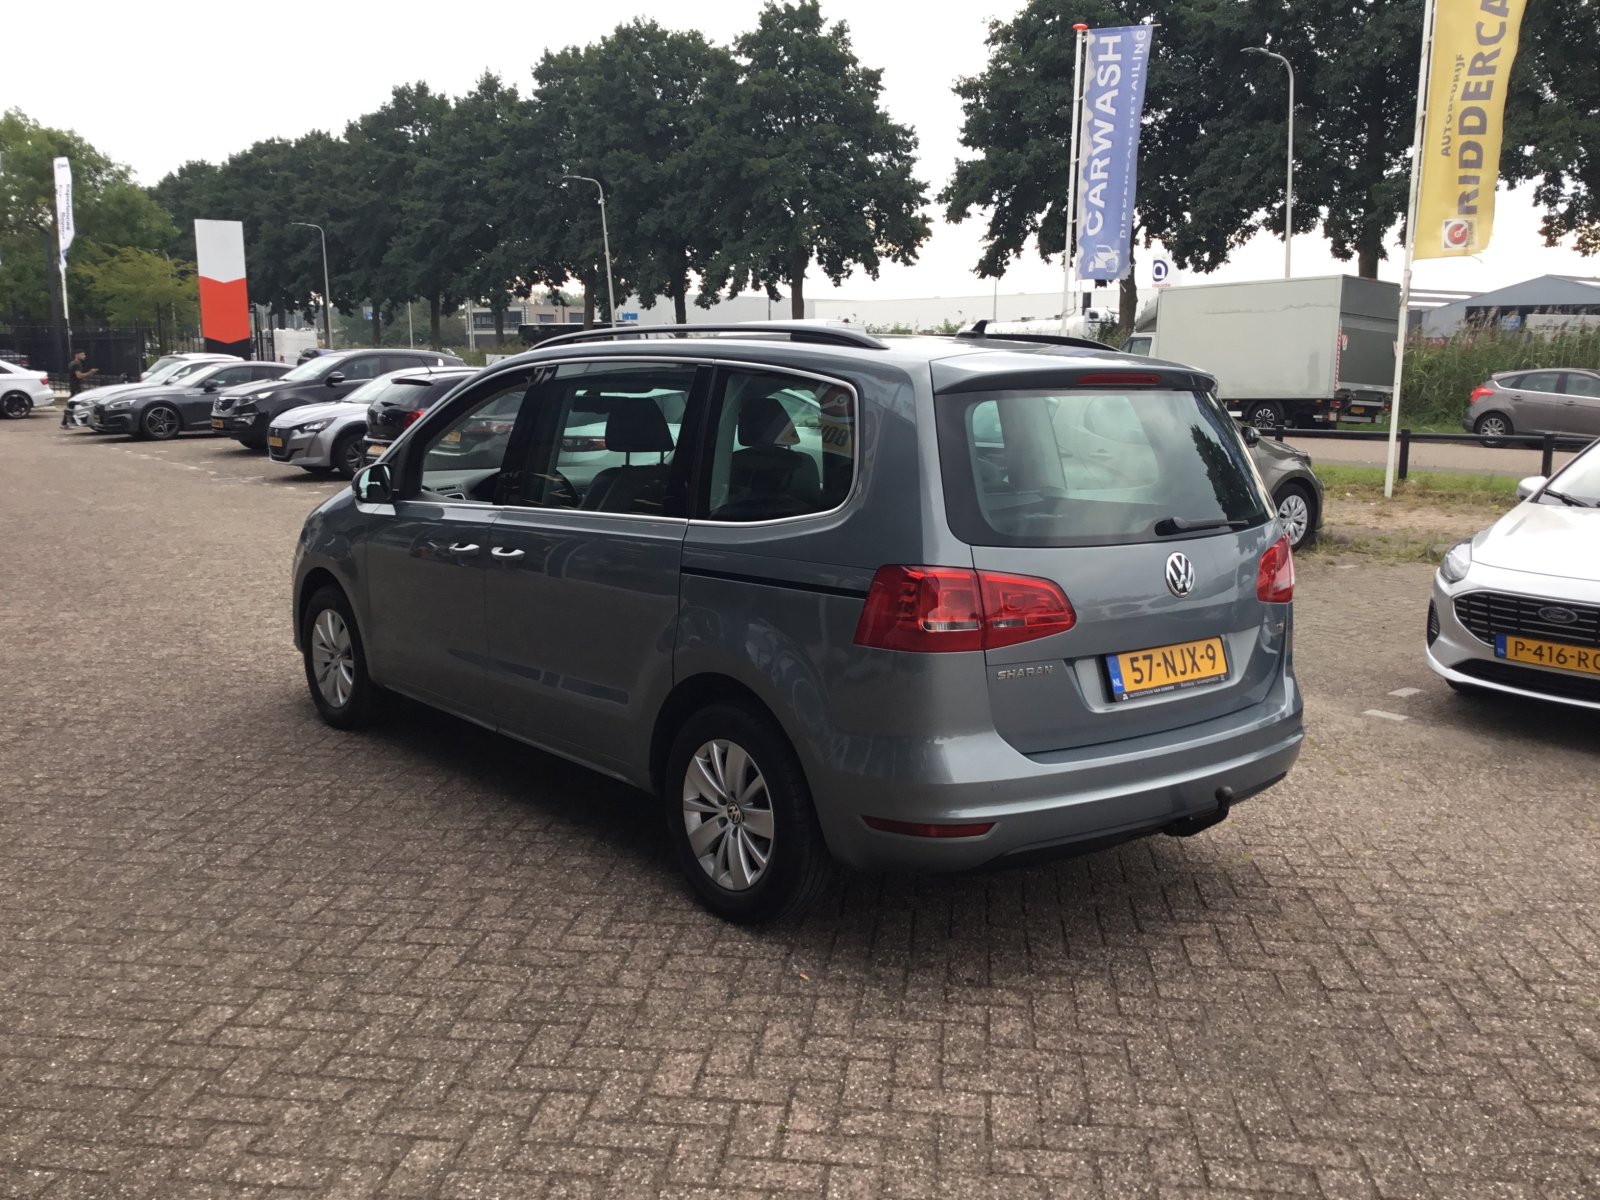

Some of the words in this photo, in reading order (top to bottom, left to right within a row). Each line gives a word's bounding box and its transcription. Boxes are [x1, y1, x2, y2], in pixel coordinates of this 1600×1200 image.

[1129, 30, 1146, 128] DETAILING
[1441, 54, 1465, 157] AUTOBEDRIJF
[1086, 35, 1121, 236] CARWASH
[997, 664, 1053, 681] SHARAN
[1112, 678, 1122, 687] NL
[1129, 643, 1217, 684] 57-NJX-9
